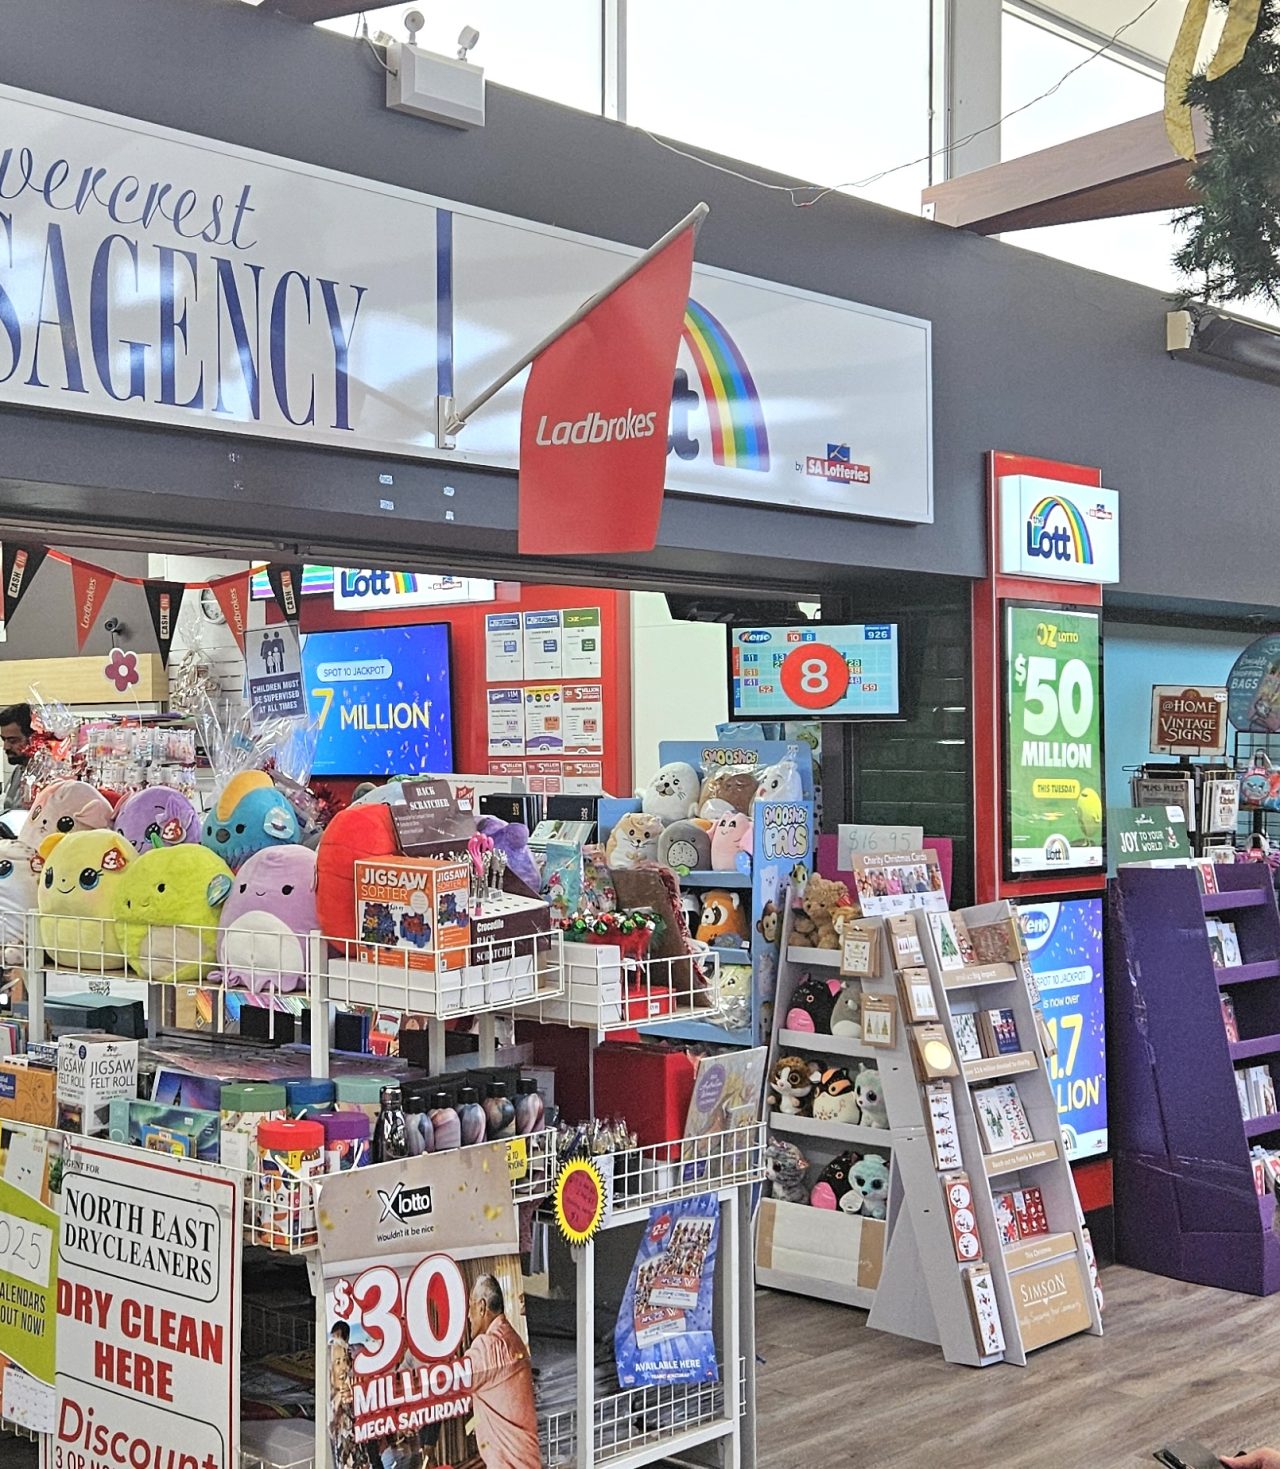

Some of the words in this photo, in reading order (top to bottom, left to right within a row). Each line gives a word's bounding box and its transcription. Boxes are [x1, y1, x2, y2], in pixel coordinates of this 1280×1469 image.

[536, 408, 657, 446] Ladbrokes
[808, 459, 823, 475] SA
[824, 462, 869, 482] Lotteries
[1027, 520, 1071, 562] Lott
[9, 571, 23, 595] CASH
[81, 576, 96, 629] Ladbrokes
[286, 590, 295, 612] CASH
[231, 588, 243, 635] Ladbrokes
[160, 612, 169, 638] CASH
[868, 630, 888, 639] 926
[323, 668, 341, 677] SPOT
[344, 668, 351, 677] 10
[353, 666, 385, 677] JACKPOT
[800, 659, 829, 693] 8
[252, 682, 281, 694] CHILDREN
[282, 680, 299, 690] MUST
[1231, 677, 1258, 689] BAGS
[263, 690, 300, 703] SUPERVISED
[1014, 653, 1093, 738] $50
[267, 704, 278, 713] ALL
[279, 701, 298, 712] TIMES
[1161, 716, 1216, 732] VINTAGE
[1168, 729, 1211, 742] SIGNS
[1021, 741, 1092, 768] MILLION
[415, 786, 435, 797] BACK
[1038, 784, 1050, 793] THIS
[1052, 785, 1076, 793] TUESDAY
[409, 799, 450, 811] SCRATCHER
[764, 825, 808, 860] PALS
[1120, 831, 1139, 853] JOY
[1139, 832, 1147, 840] TO
[1148, 831, 1164, 839] YOUR
[1142, 842, 1163, 851] WORLD
[863, 856, 884, 866] Charity
[884, 854, 911, 864] Christmas
[911, 852, 927, 861] Cards
[361, 868, 427, 891] JIGSAW
[437, 869, 467, 882] JIGSAW
[361, 884, 408, 900] SORTER
[1054, 975, 1060, 984] 10
[1060, 970, 1086, 984] JACKPOT
[1050, 998, 1064, 1008] now
[1064, 995, 1080, 1006] over
[58, 1056, 86, 1074] JIGSAW
[90, 1059, 136, 1077] JIGSAW
[58, 1072, 70, 1084] FELT
[71, 1076, 86, 1088] ROLL
[91, 1078, 109, 1089] FELT
[113, 1075, 135, 1087] ROLL
[1057, 1077, 1099, 1114] LION
[86, 1163, 100, 1174] FOR
[64, 1188, 144, 1235] NORTH
[152, 1209, 214, 1252] EAST
[377, 1231, 404, 1242] Wouldn't
[421, 1225, 434, 1233] nice
[64, 1223, 212, 1286] DRYCLEANERS
[1021, 1273, 1066, 1303] SIMSON
[0, 1305, 17, 1327] OUT
[21, 1311, 45, 1337] NOW!
[56, 1278, 113, 1330] DRY
[120, 1298, 224, 1365] CLEAN
[332, 1253, 468, 1377] $30
[94, 1340, 174, 1402] HERE
[635, 1361, 678, 1372] AVAILABLE
[679, 1359, 700, 1369] HERE
[353, 1355, 473, 1418] MILLION
[354, 1413, 397, 1443] MEGA
[397, 1394, 472, 1435] SATURDAY
